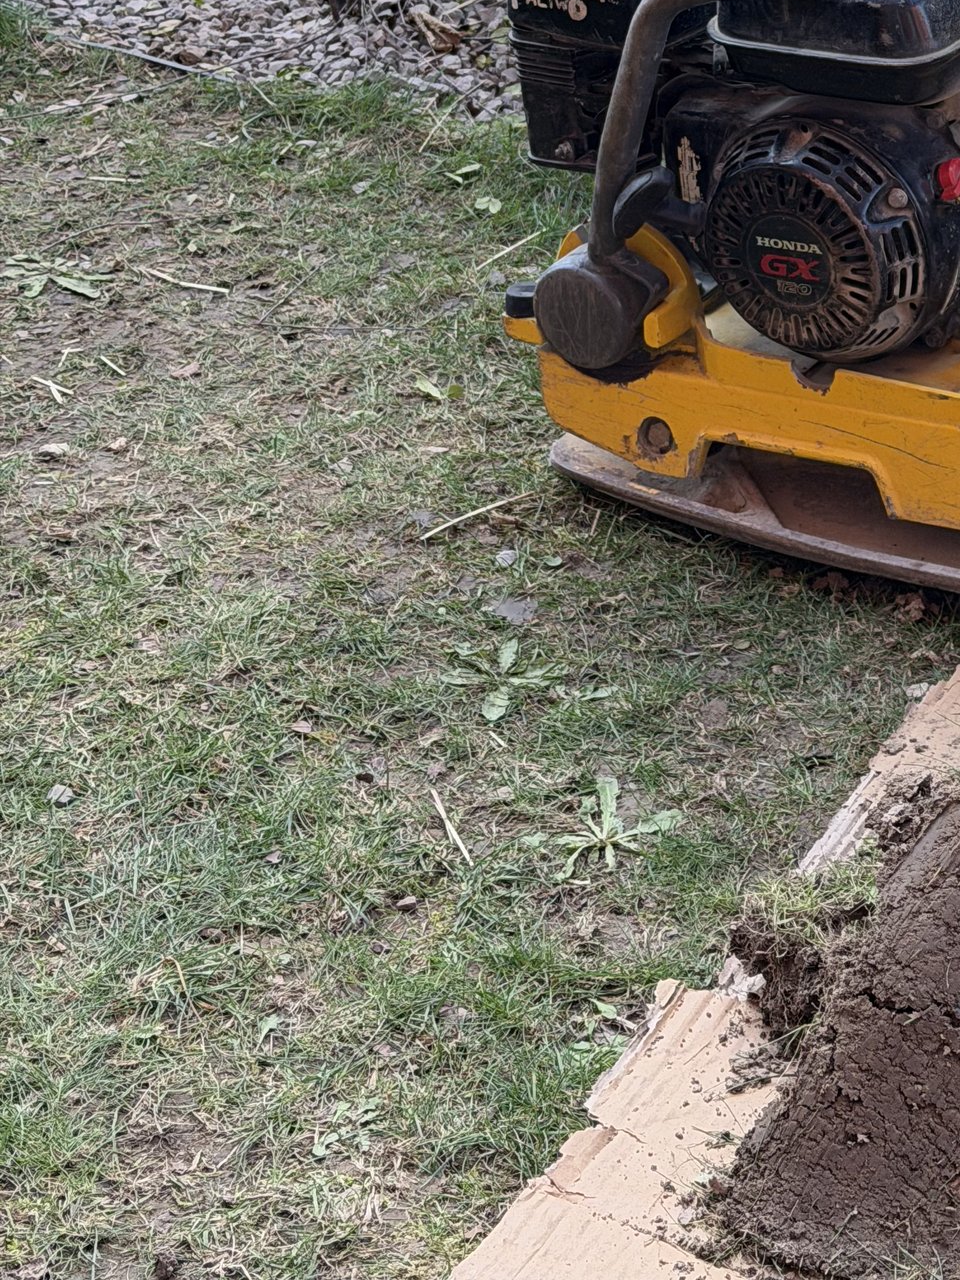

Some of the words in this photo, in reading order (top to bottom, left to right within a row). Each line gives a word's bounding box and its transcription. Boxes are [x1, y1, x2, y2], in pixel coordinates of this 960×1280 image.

[755, 235, 823, 255] HONDA
[760, 253, 820, 281] GX
[777, 279, 812, 296] 120
